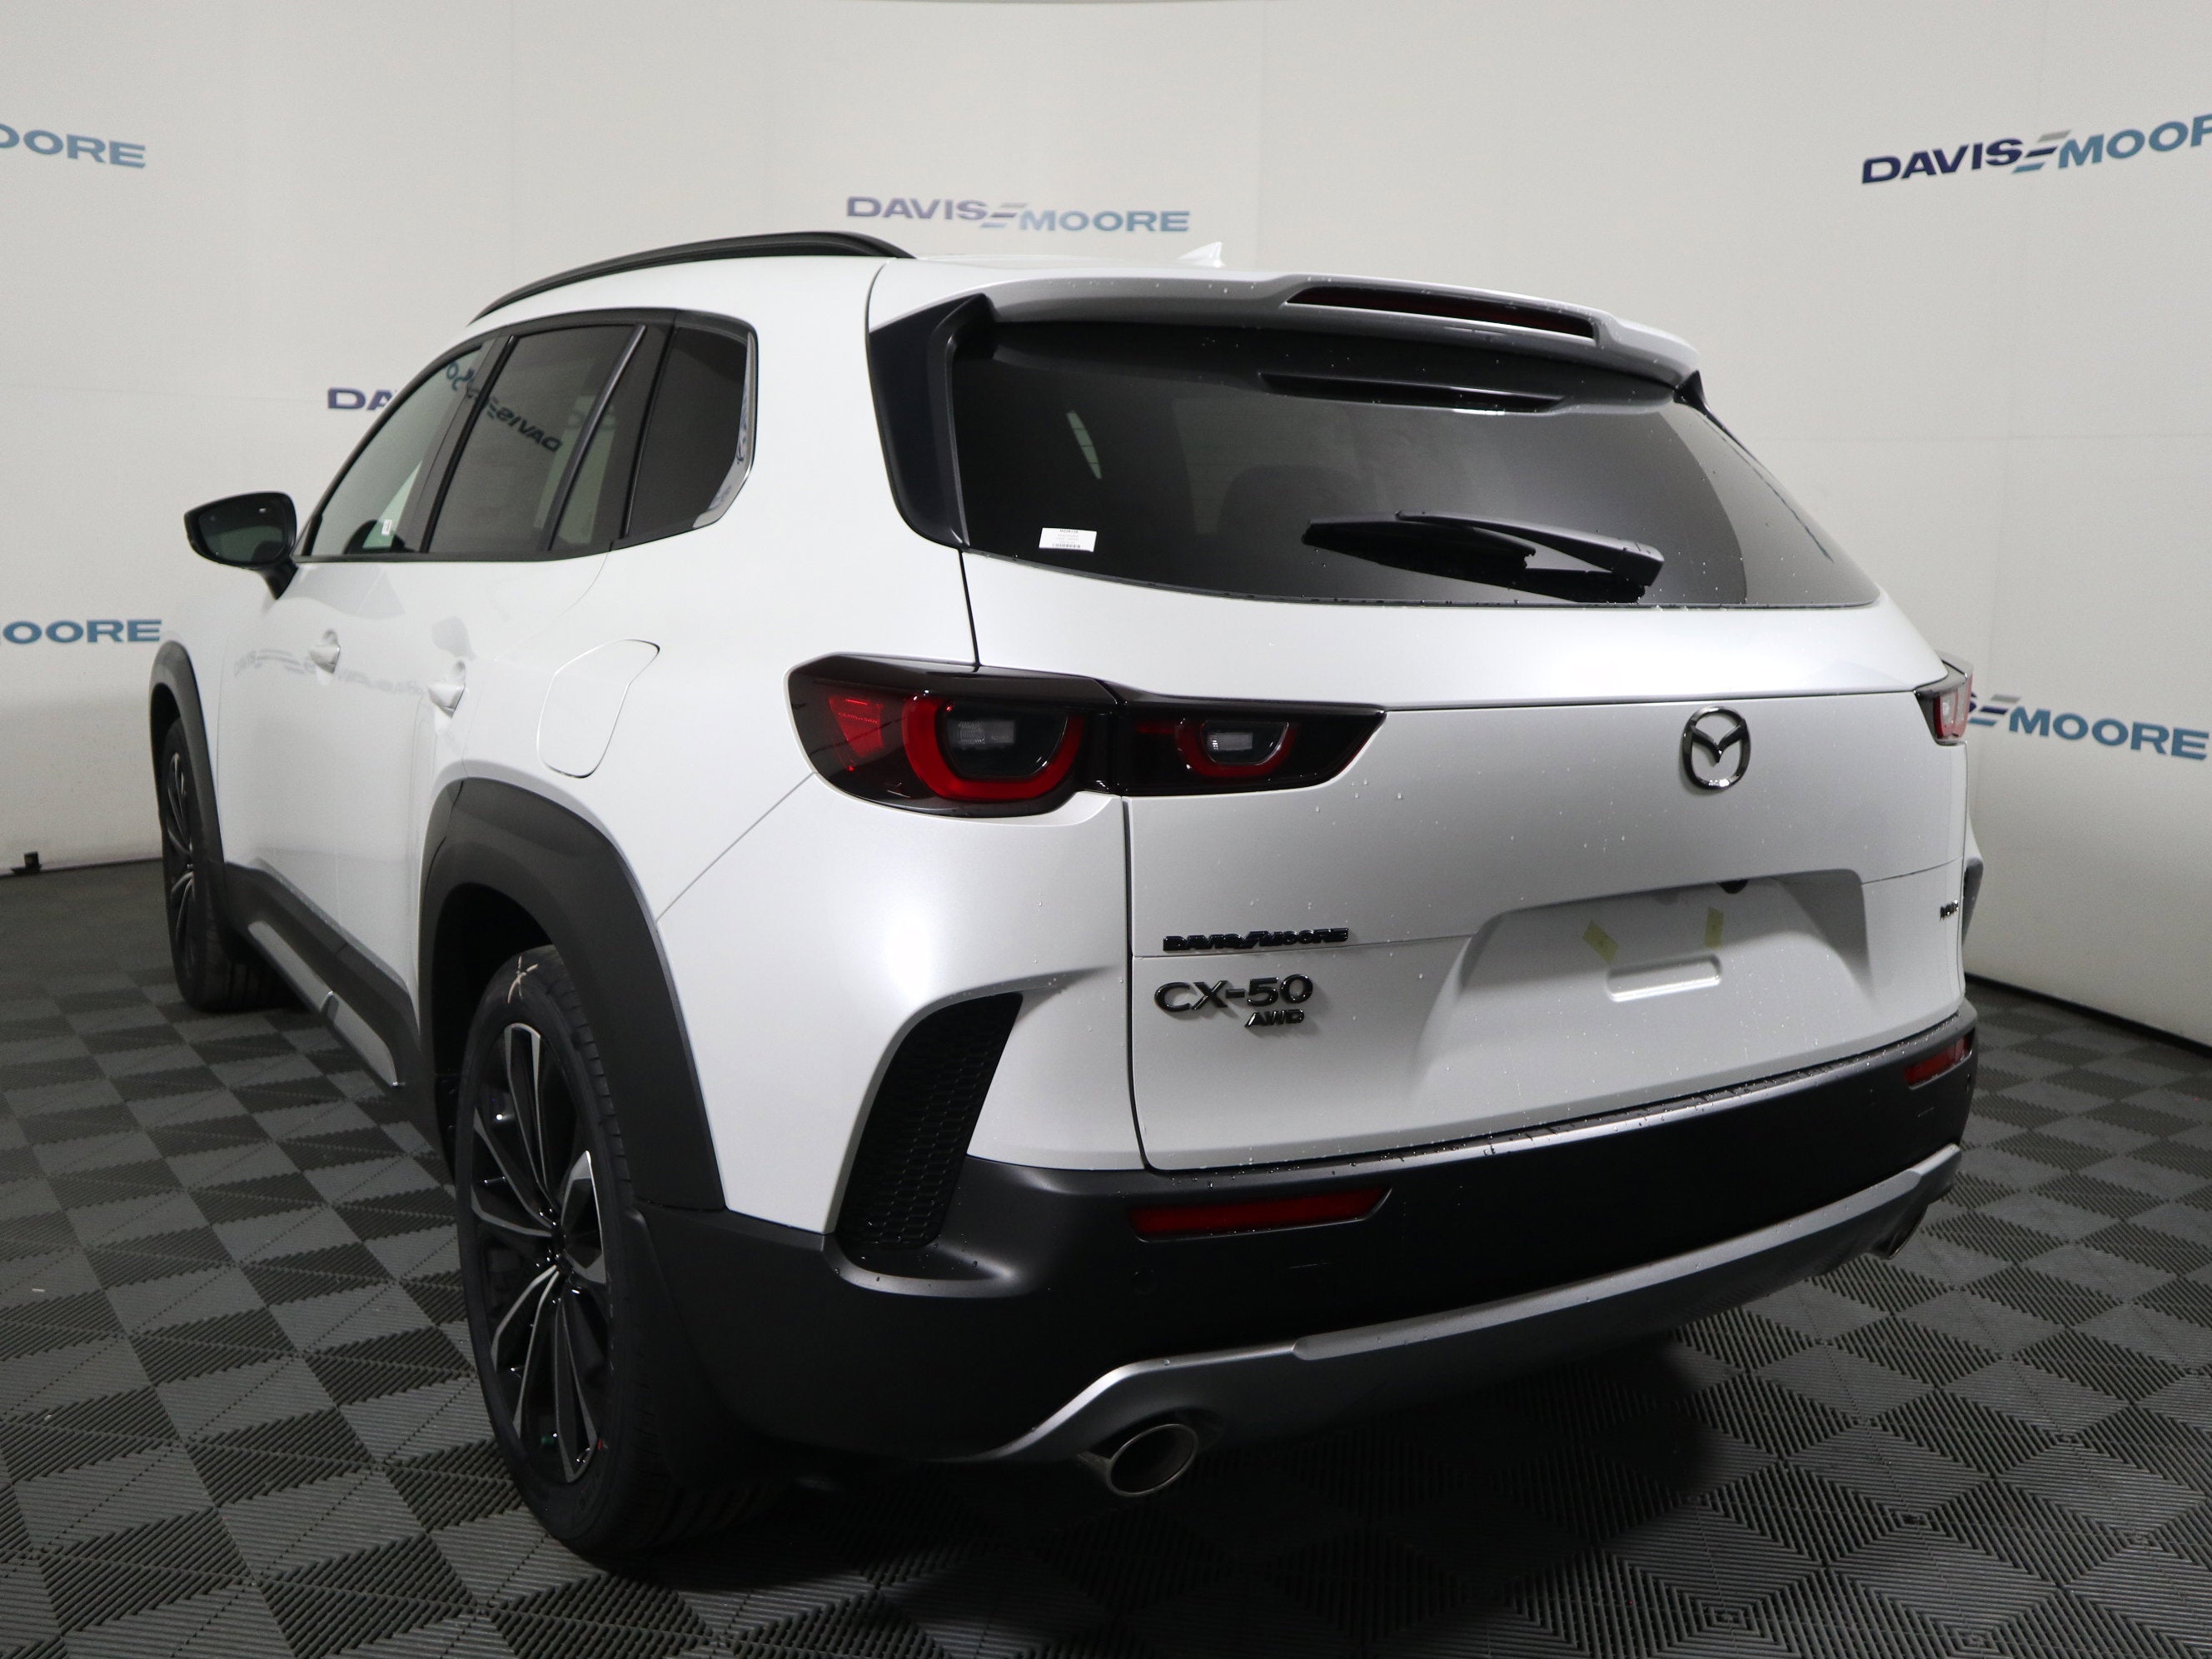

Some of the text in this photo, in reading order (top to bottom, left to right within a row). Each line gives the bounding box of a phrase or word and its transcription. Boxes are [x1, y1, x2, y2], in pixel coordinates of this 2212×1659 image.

[1861, 138, 2023, 184] DAVIS
[846, 196, 1190, 232] DAVIS MOORE
[2008, 705, 2210, 761] MOORE
[1153, 973, 1313, 1013] CX-50
[1244, 1008, 1306, 1028] AWD
